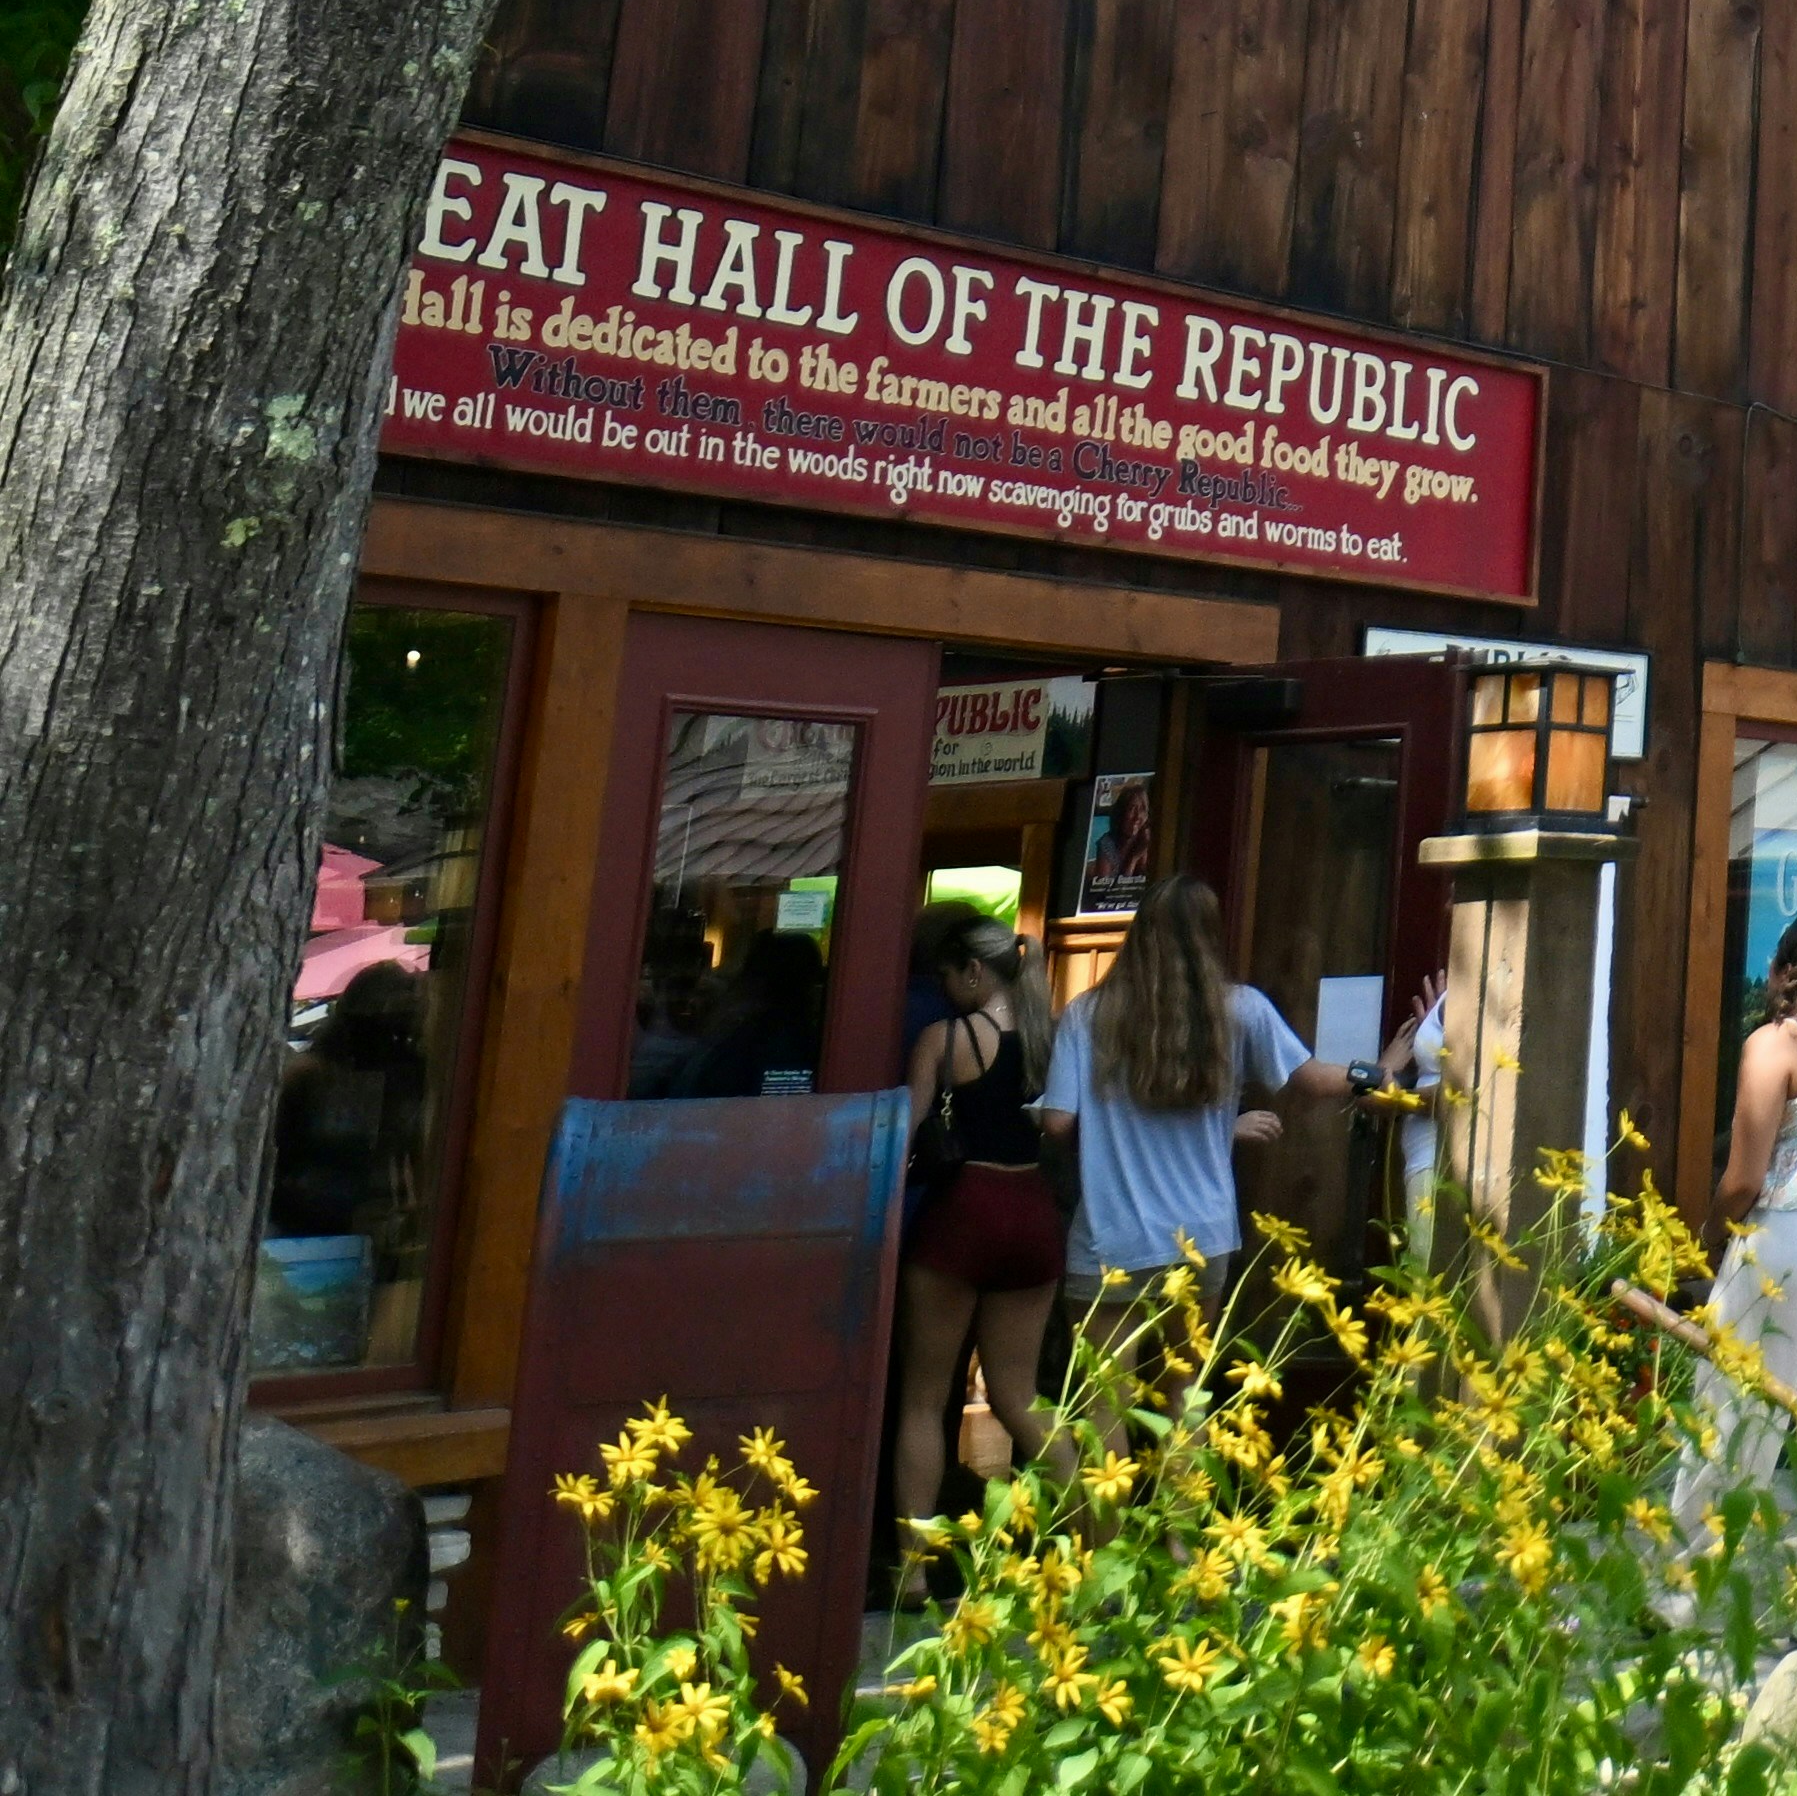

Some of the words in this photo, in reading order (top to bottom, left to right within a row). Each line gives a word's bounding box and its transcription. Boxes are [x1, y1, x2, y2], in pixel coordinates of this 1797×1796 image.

[493, 290, 533, 341] is
[541, 295, 738, 375] dedicated
[748, 337, 789, 383] to
[799, 343, 859, 394] the
[864, 355, 1002, 420] farmers
[1007, 387, 1069, 434] and
[1072, 393, 1118, 441] all
[1119, 403, 1173, 450] the
[1176, 420, 1255, 464] good
[1260, 424, 1330, 478] food
[1334, 441, 1400, 499] they
[1404, 465, 1479, 504] grow.
[631, 201, 860, 335] HALL
[885, 256, 995, 355] OF
[1015, 275, 1160, 391] THE
[1175, 314, 1479, 451] REPUBLIC
[402, 388, 447, 422] we
[452, 391, 497, 429] all
[505, 404, 595, 443] would
[601, 410, 638, 450] be
[645, 423, 692, 457] out
[698, 427, 725, 462] in
[732, 431, 781, 469] the
[788, 444, 869, 481] woods
[872, 454, 933, 505] right
[937, 469, 987, 498] now
[988, 478, 1112, 532] scavenging
[1116, 492, 1149, 522] for
[1148, 500, 1213, 541] grubs
[1217, 510, 1259, 540] and
[1264, 520, 1337, 552] worms
[1340, 523, 1363, 556] to
[1366, 532, 1408, 563] eat.
[486, 342, 646, 410] Without
[763, 395, 845, 442] there
[852, 412, 949, 455] would
[953, 431, 1004, 463] not
[1009, 429, 1044, 468] be
[1047, 447, 1063, 473] a
[1072, 439, 1173, 499] Cherry
[932, 737, 960, 761] for
[935, 687, 1042, 736] PUBLIC
[971, 757, 993, 774] the
[993, 750, 1036, 772] world
